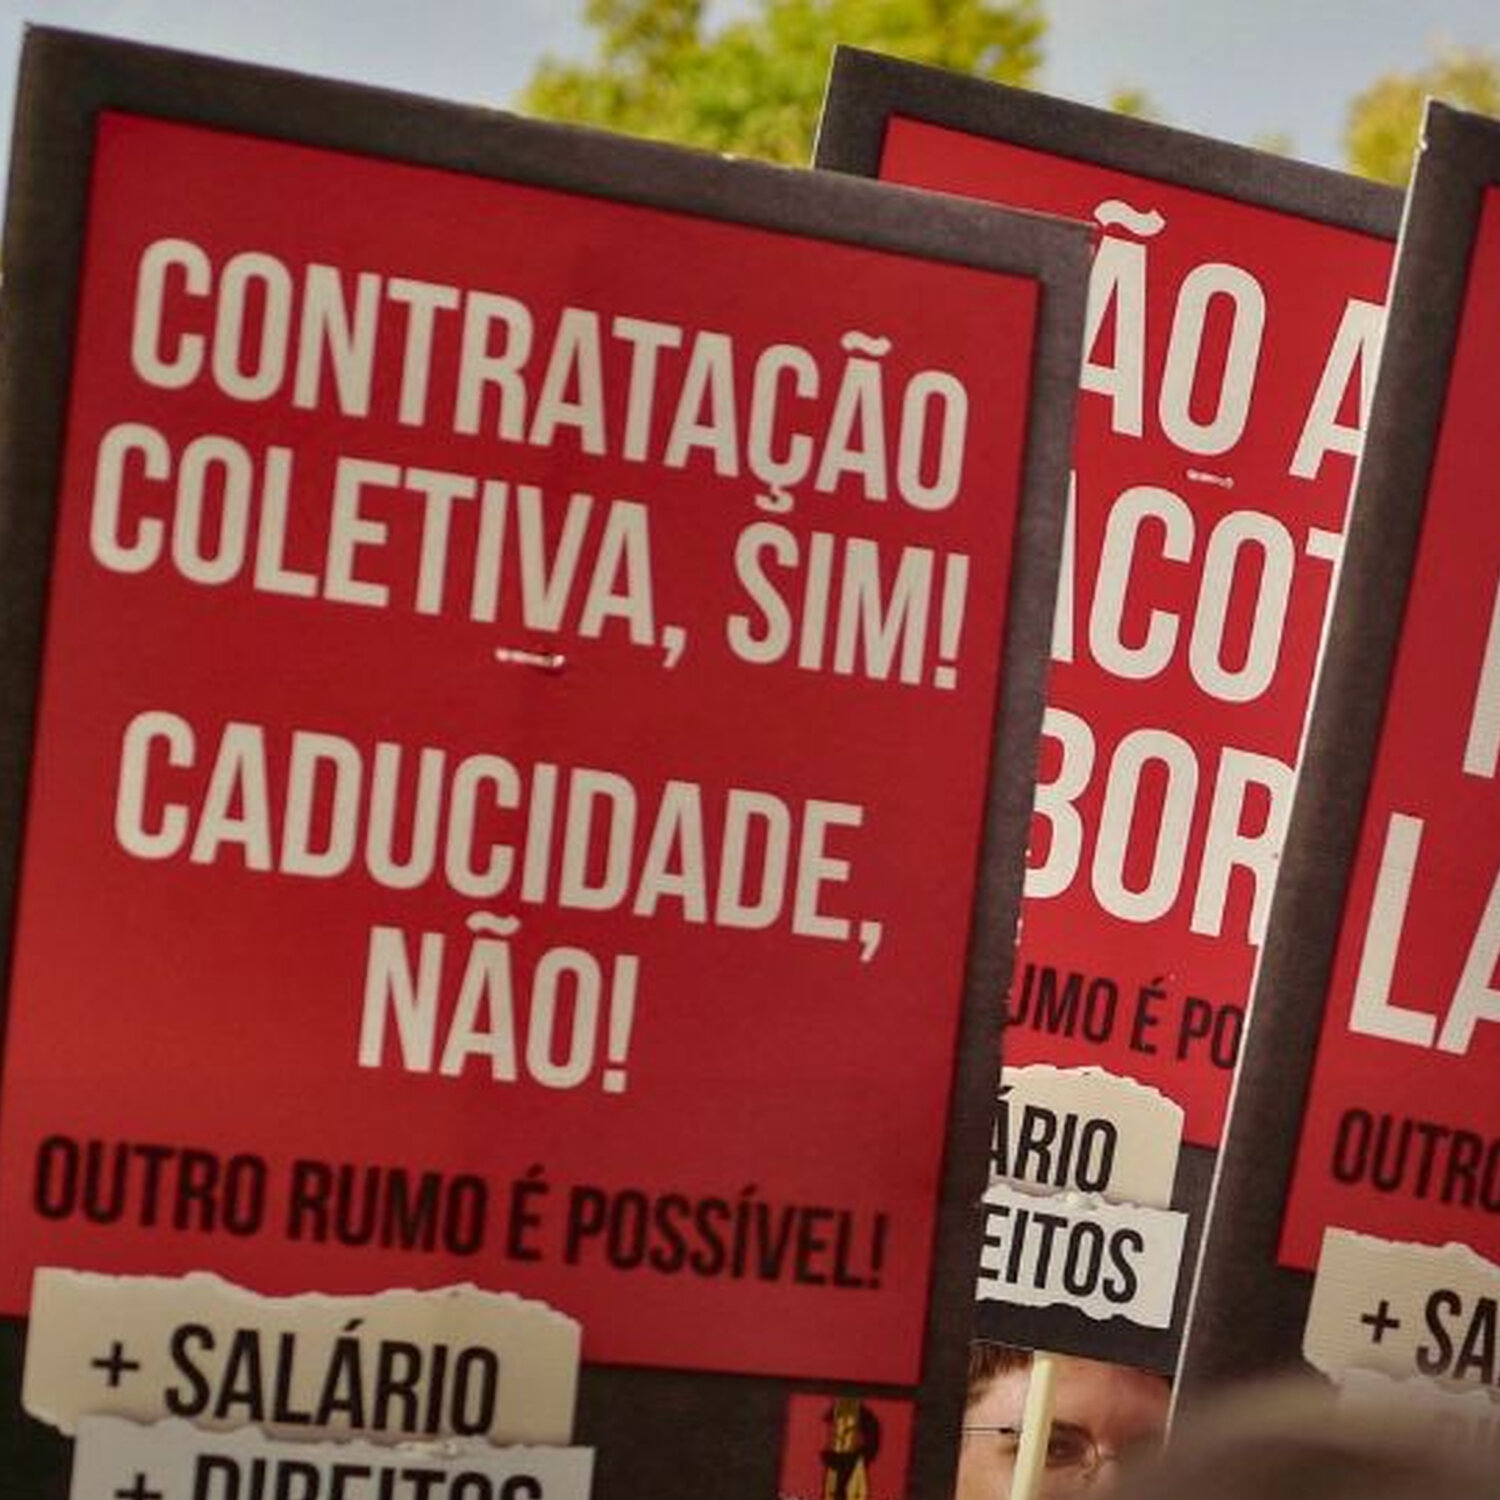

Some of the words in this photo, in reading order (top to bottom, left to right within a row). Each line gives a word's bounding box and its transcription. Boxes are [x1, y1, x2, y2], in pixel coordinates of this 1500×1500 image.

[133, 239, 967, 512] CONTRATAÇÃO
[91, 424, 687, 668] COLETIVA,
[728, 515, 968, 690] SIM!
[1051, 470, 1343, 702] CO
[116, 712, 882, 962] CADUCIDADE,
[359, 912, 638, 1093] NÃO!
[1130, 977, 1166, 1055] É
[34, 1136, 267, 1236] OUTRO
[288, 1160, 489, 1256] RUMO
[506, 1165, 548, 1264] É
[565, 1184, 889, 1290] POSSÍVEL!
[164, 1320, 498, 1448] SALÁRIO
